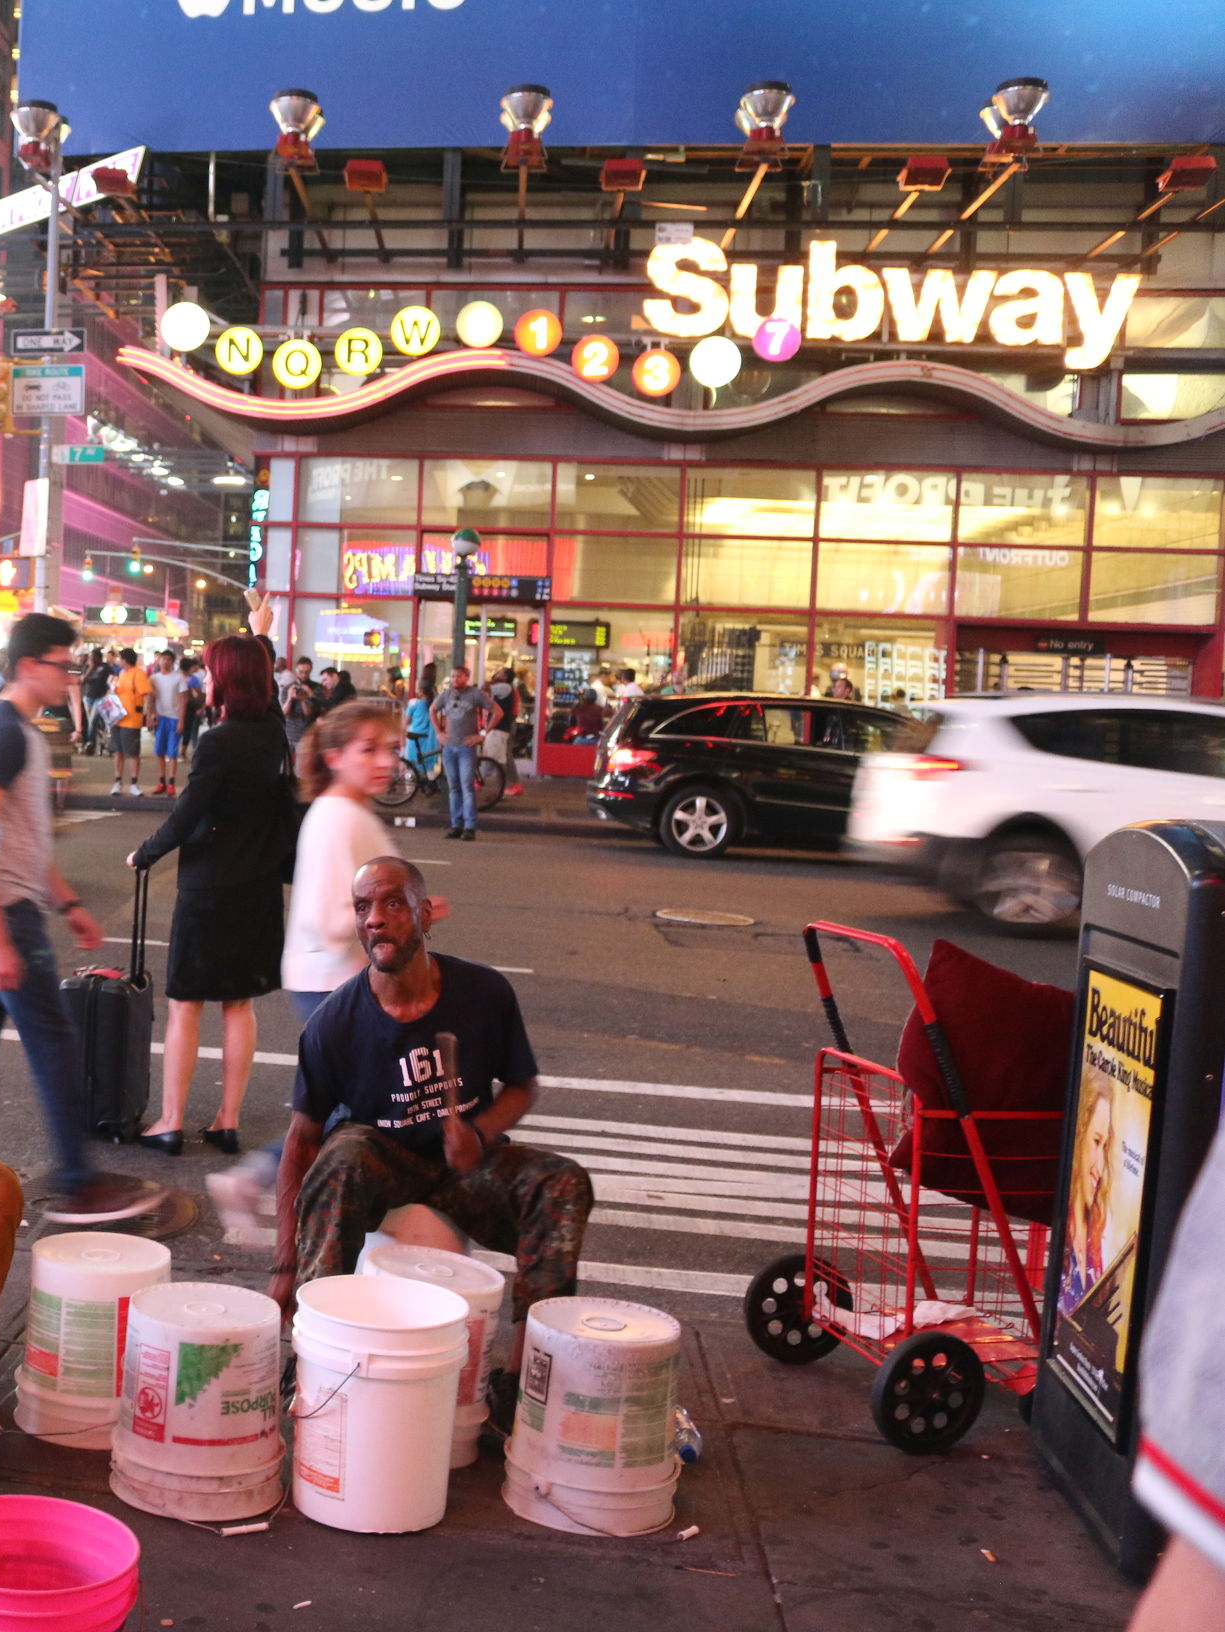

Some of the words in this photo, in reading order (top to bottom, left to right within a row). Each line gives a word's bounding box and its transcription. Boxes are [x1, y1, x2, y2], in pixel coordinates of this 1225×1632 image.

[642, 237, 1143, 369] Subway
[22, 338, 42, 348] ONE
[53, 337, 74, 346] WAY
[227, 336, 250, 364] N
[285, 350, 308, 377] Q
[347, 338, 369, 364] R
[400, 319, 432, 347] W
[529, 316, 549, 350] 1
[582, 341, 610, 376] 2
[642, 355, 671, 391] 3
[765, 322, 791, 355] 7
[73, 447, 83, 462] 7
[783, 642, 825, 656] TIMS
[1049, 640, 1064, 649] No
[1068, 641, 1094, 651] entry
[1107, 884, 1125, 899] SOLAR
[1126, 889, 1161, 909] COMPACTOR
[399, 1046, 444, 1087] 161
[391, 1090, 421, 1103] PROUDLY
[424, 1077, 464, 1095] SUPPORTS
[1132, 1069, 1154, 1099] Musica
[421, 1097, 442, 1109] STREET
